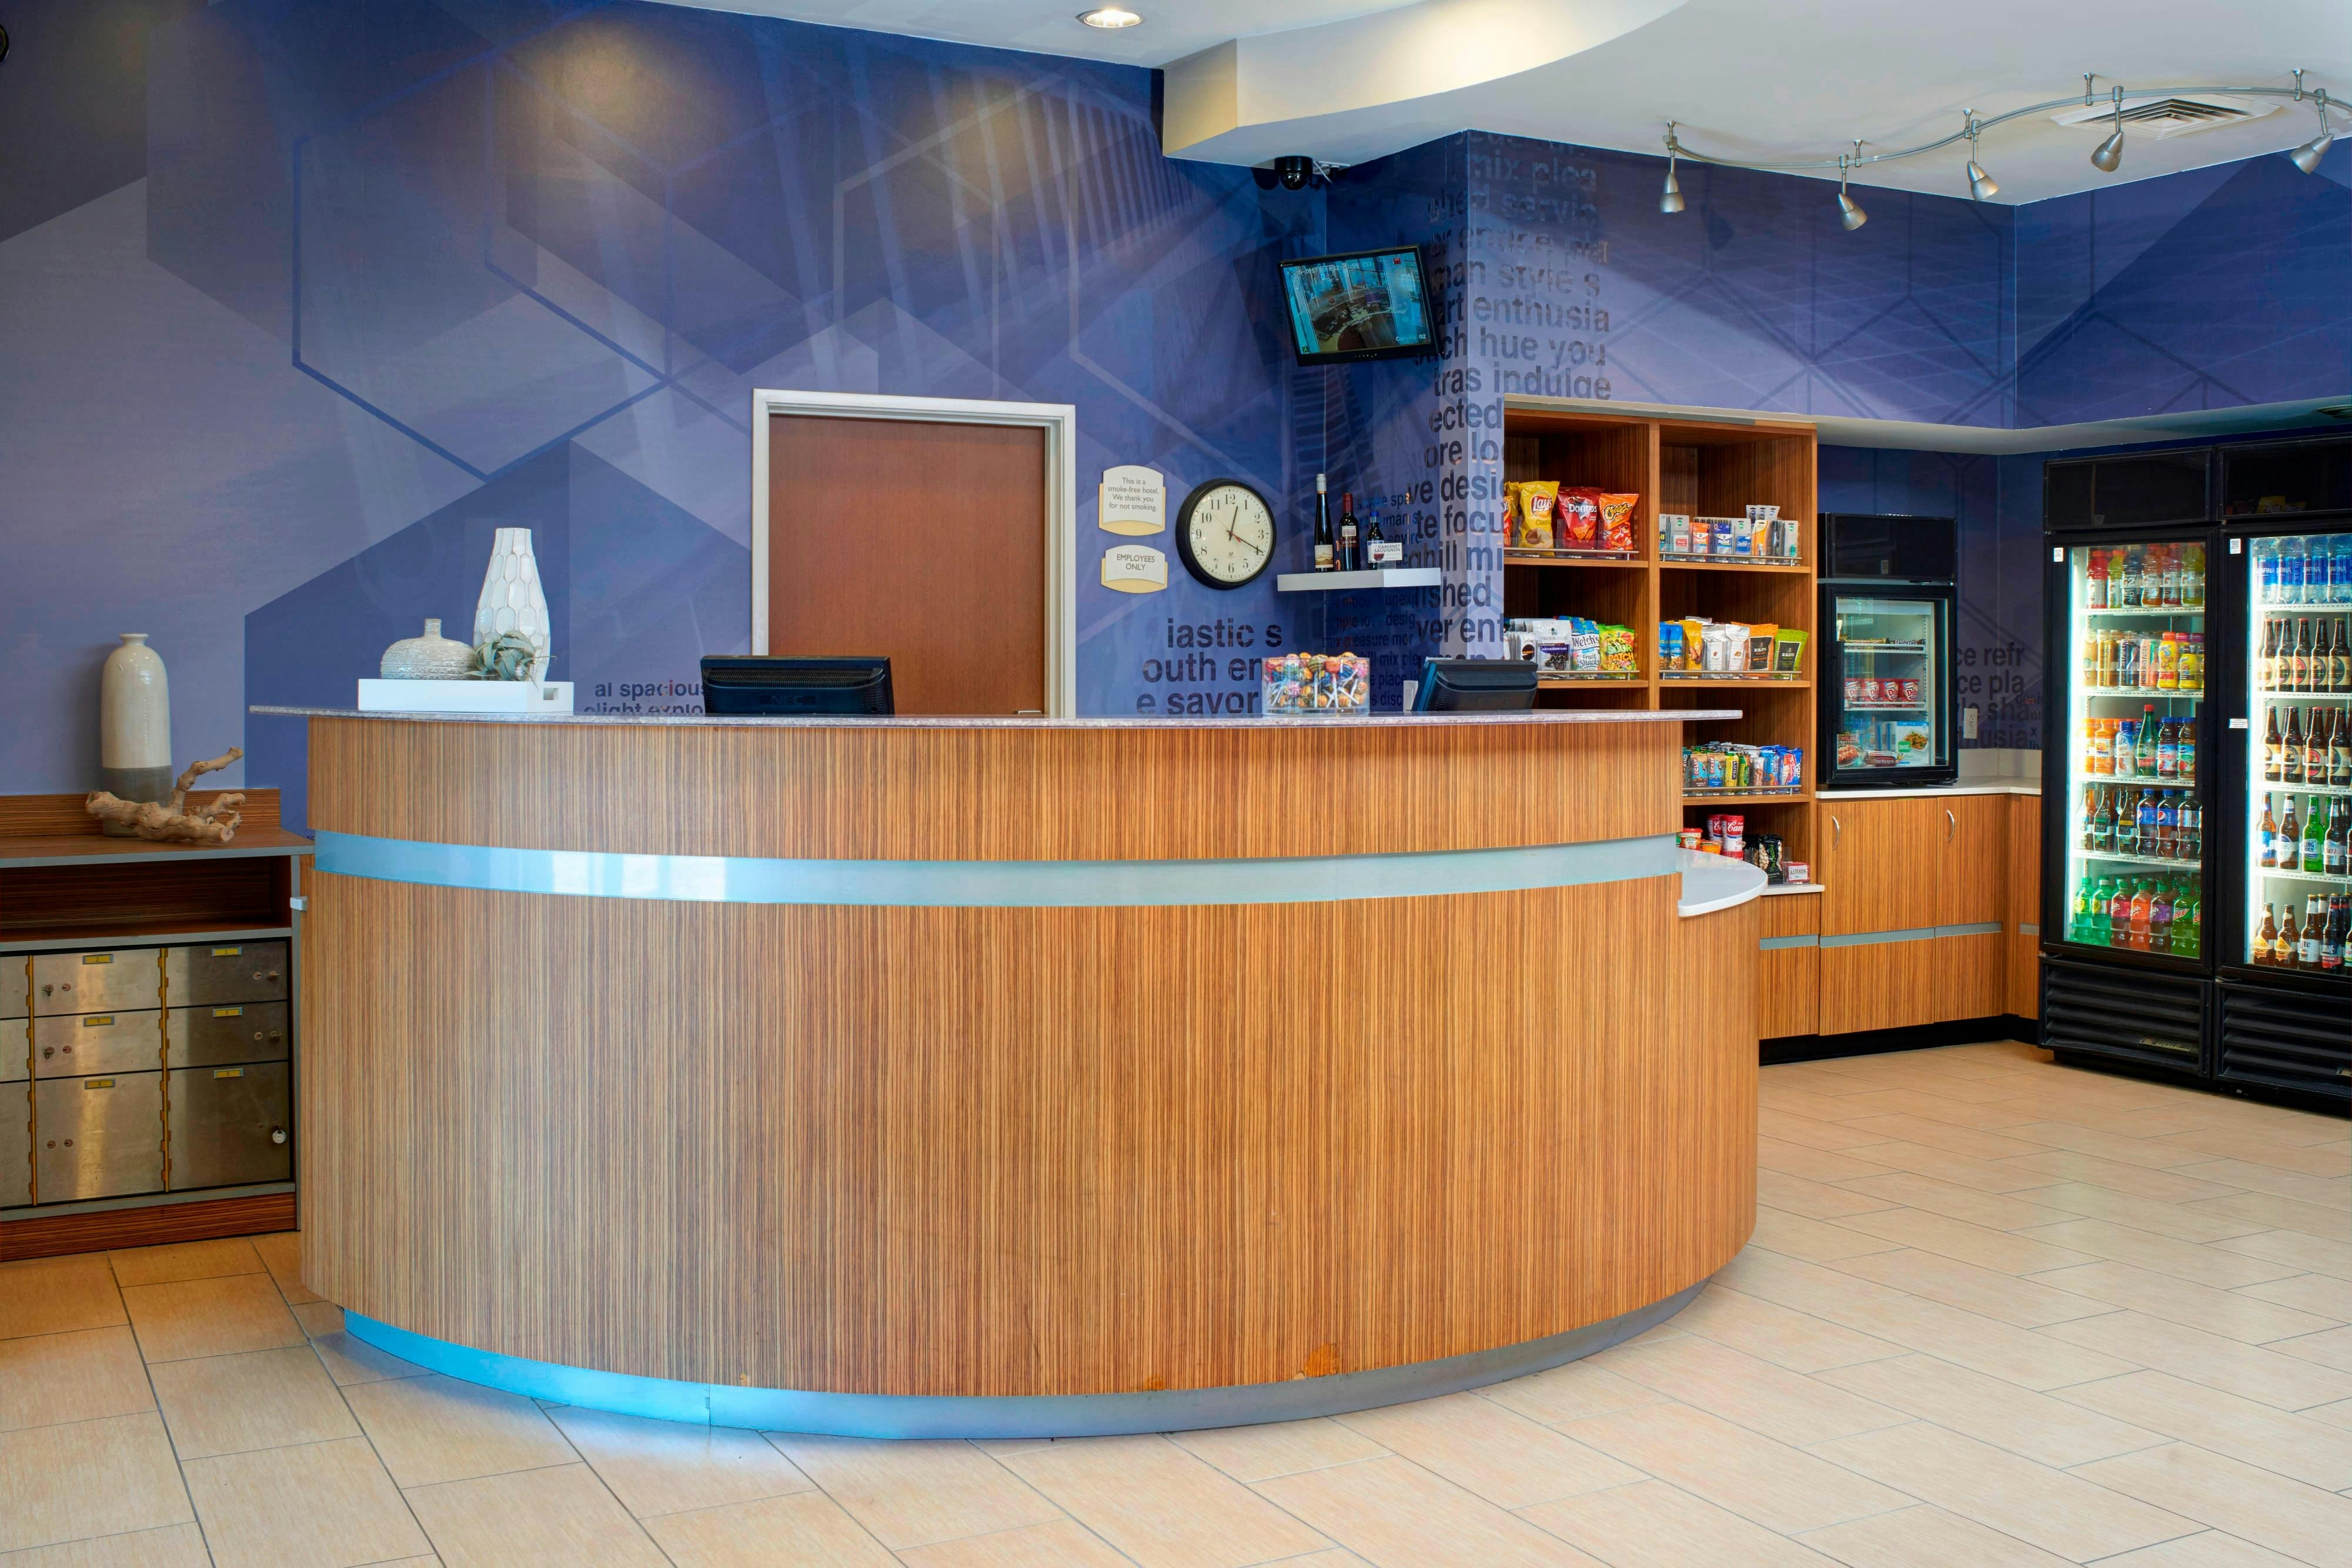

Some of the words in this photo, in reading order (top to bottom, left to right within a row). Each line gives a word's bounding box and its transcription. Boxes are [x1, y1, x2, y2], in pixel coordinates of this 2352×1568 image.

[1498, 260, 1573, 297] style
[1583, 273, 1600, 297] s
[1473, 294, 1609, 333] enthusia
[1479, 325, 1538, 361] hue
[1548, 337, 1606, 369] you
[1434, 367, 1481, 397] tras
[1494, 362, 1611, 400] indulge
[1429, 397, 1502, 433] ected
[1425, 440, 1462, 469] ore
[1472, 432, 1504, 465] lo
[1441, 468, 1504, 502] desi
[1131, 504, 1158, 512] smoking.
[1211, 499, 1220, 510] 11
[1225, 494, 1235, 504] 12
[1532, 496, 1552, 511] Lay's
[1569, 503, 1597, 513] Doritos
[1201, 513, 1212, 523] 10
[1117, 554, 1155, 563] EMPLOYEES
[1167, 617, 1254, 648] iastic
[1265, 624, 1282, 648] s
[1418, 618, 1452, 643] ver
[1572, 635, 1599, 647] Welch's
[1379, 650, 1399, 666] mix
[1608, 652, 1634, 661] PATCH
[1984, 642, 2024, 667] refr
[1142, 651, 1216, 683] outh
[594, 682, 612, 697] al
[1989, 669, 2024, 700] pla
[771, 696, 804, 706] NEC
[1136, 693, 1156, 715] e
[1167, 691, 1259, 715] savor
